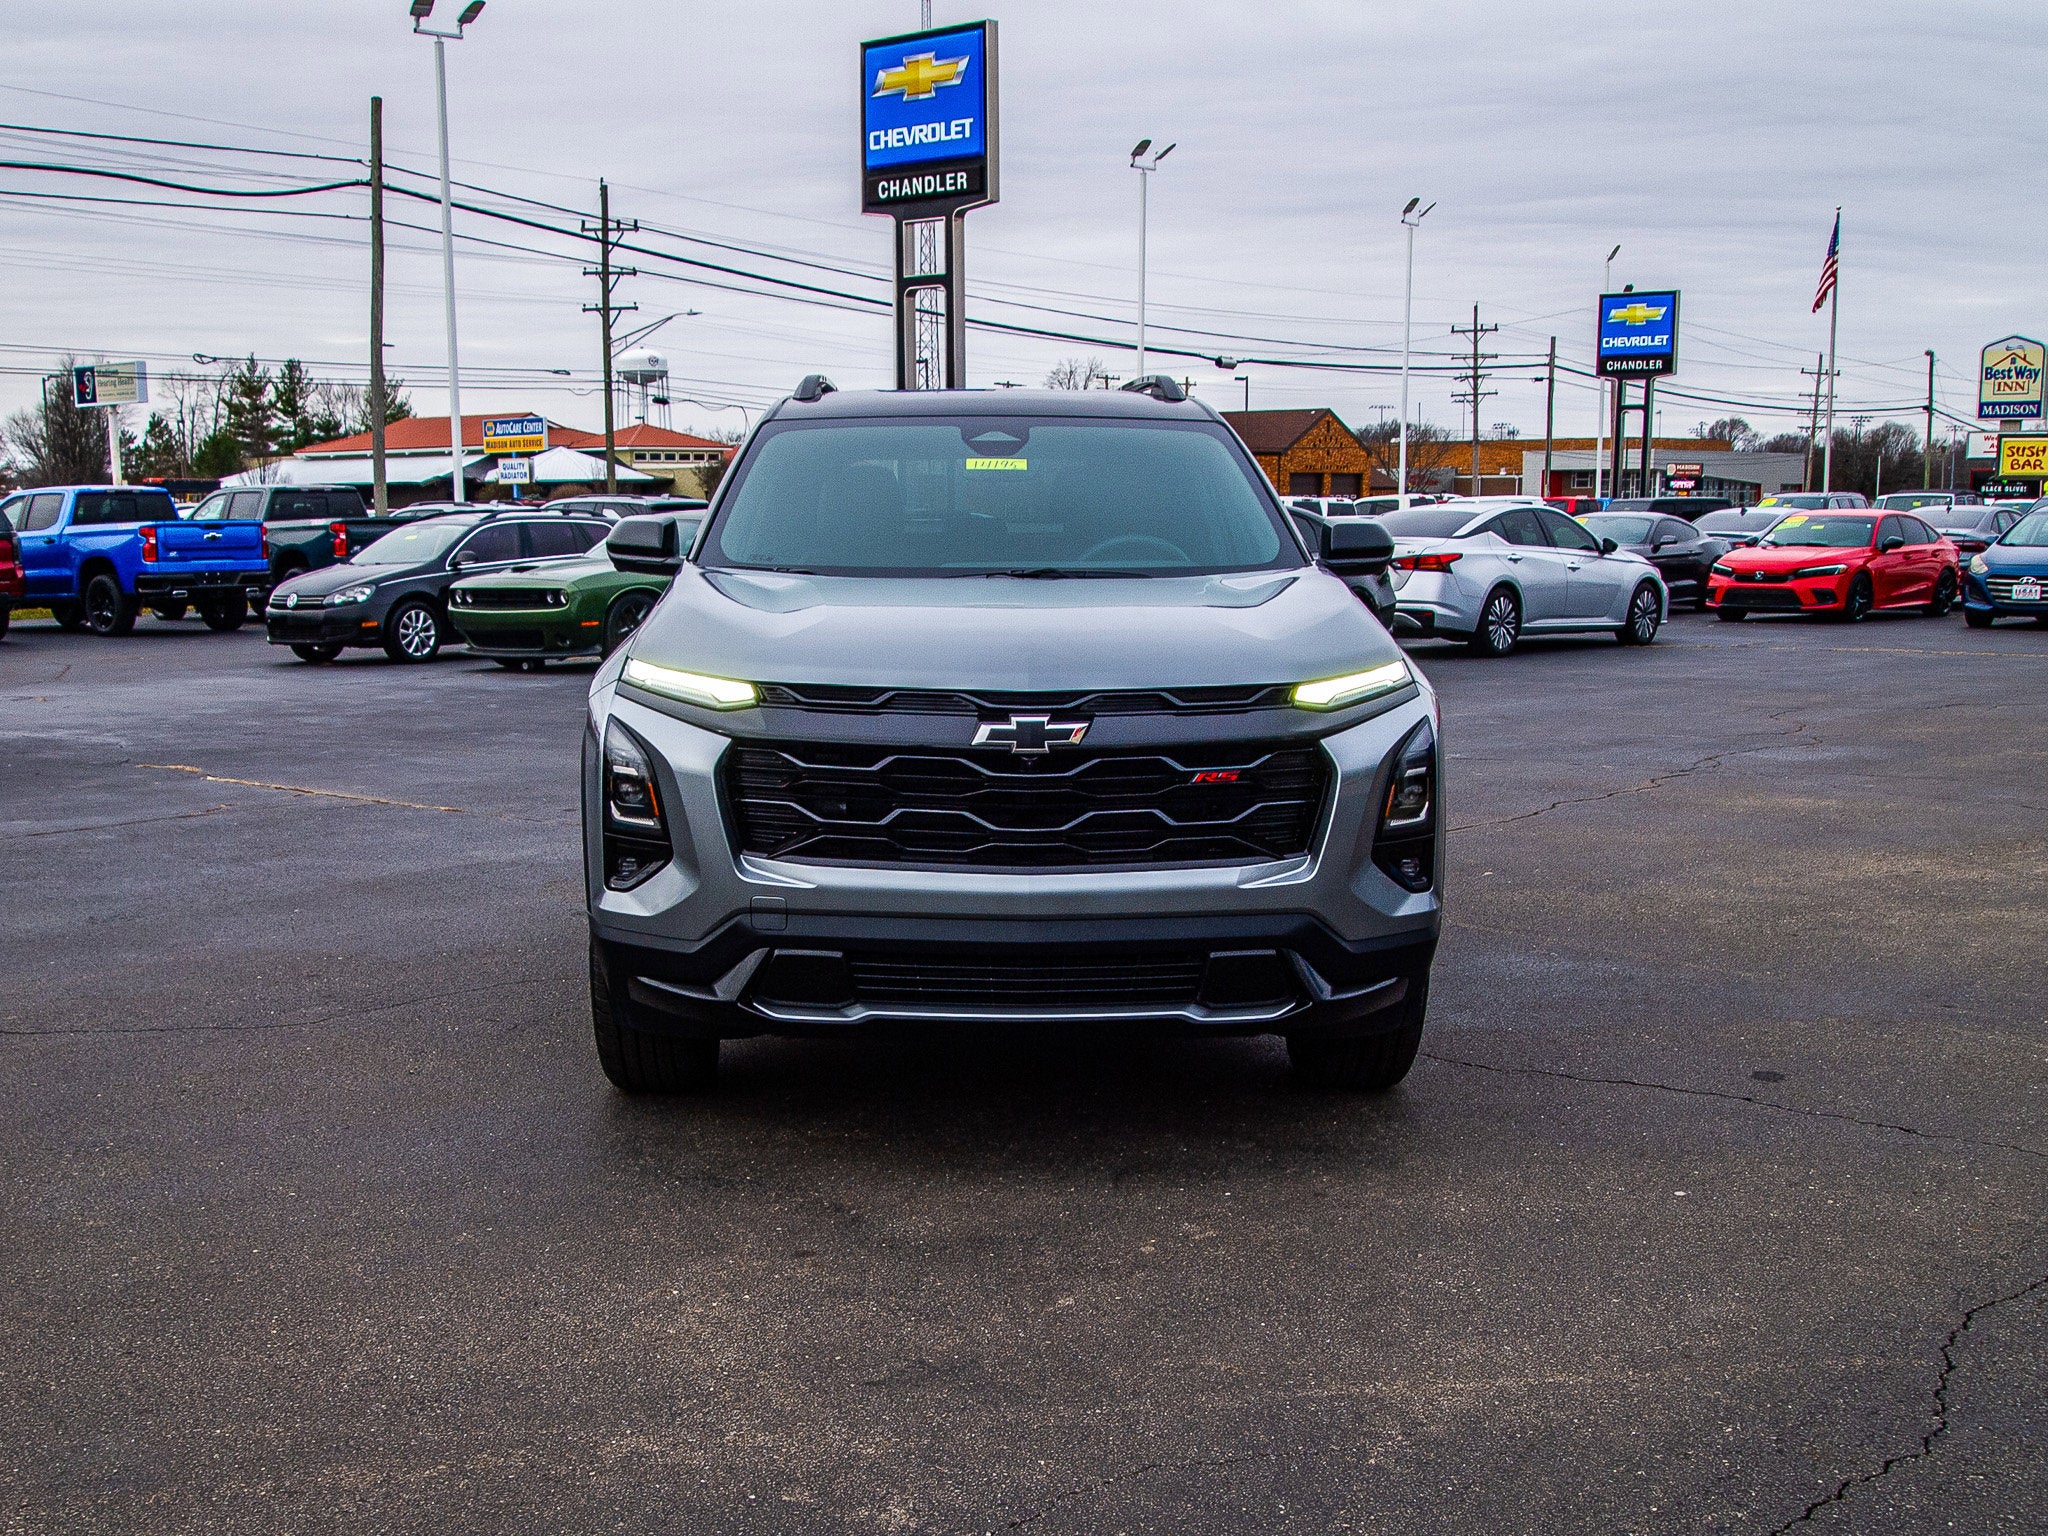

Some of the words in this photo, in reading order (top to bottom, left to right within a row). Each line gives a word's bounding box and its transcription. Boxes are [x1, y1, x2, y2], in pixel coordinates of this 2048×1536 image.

[869, 117, 974, 151] CHEVROLET
[878, 171, 968, 199] CHANDLER
[1602, 334, 1670, 348] CHEVROLET
[1606, 360, 1663, 371] CHANDLER
[1984, 366, 2013, 381] Best
[2014, 365, 2041, 384] Way
[1996, 381, 2026, 392] INN
[1981, 404, 2039, 416] MADISON
[502, 462, 526, 471] QUALITY
[2010, 458, 2044, 471] BAR
[500, 471, 528, 480] RADIATOR
[1981, 485, 2003, 493] BLACK
[1193, 770, 1241, 783] RS
